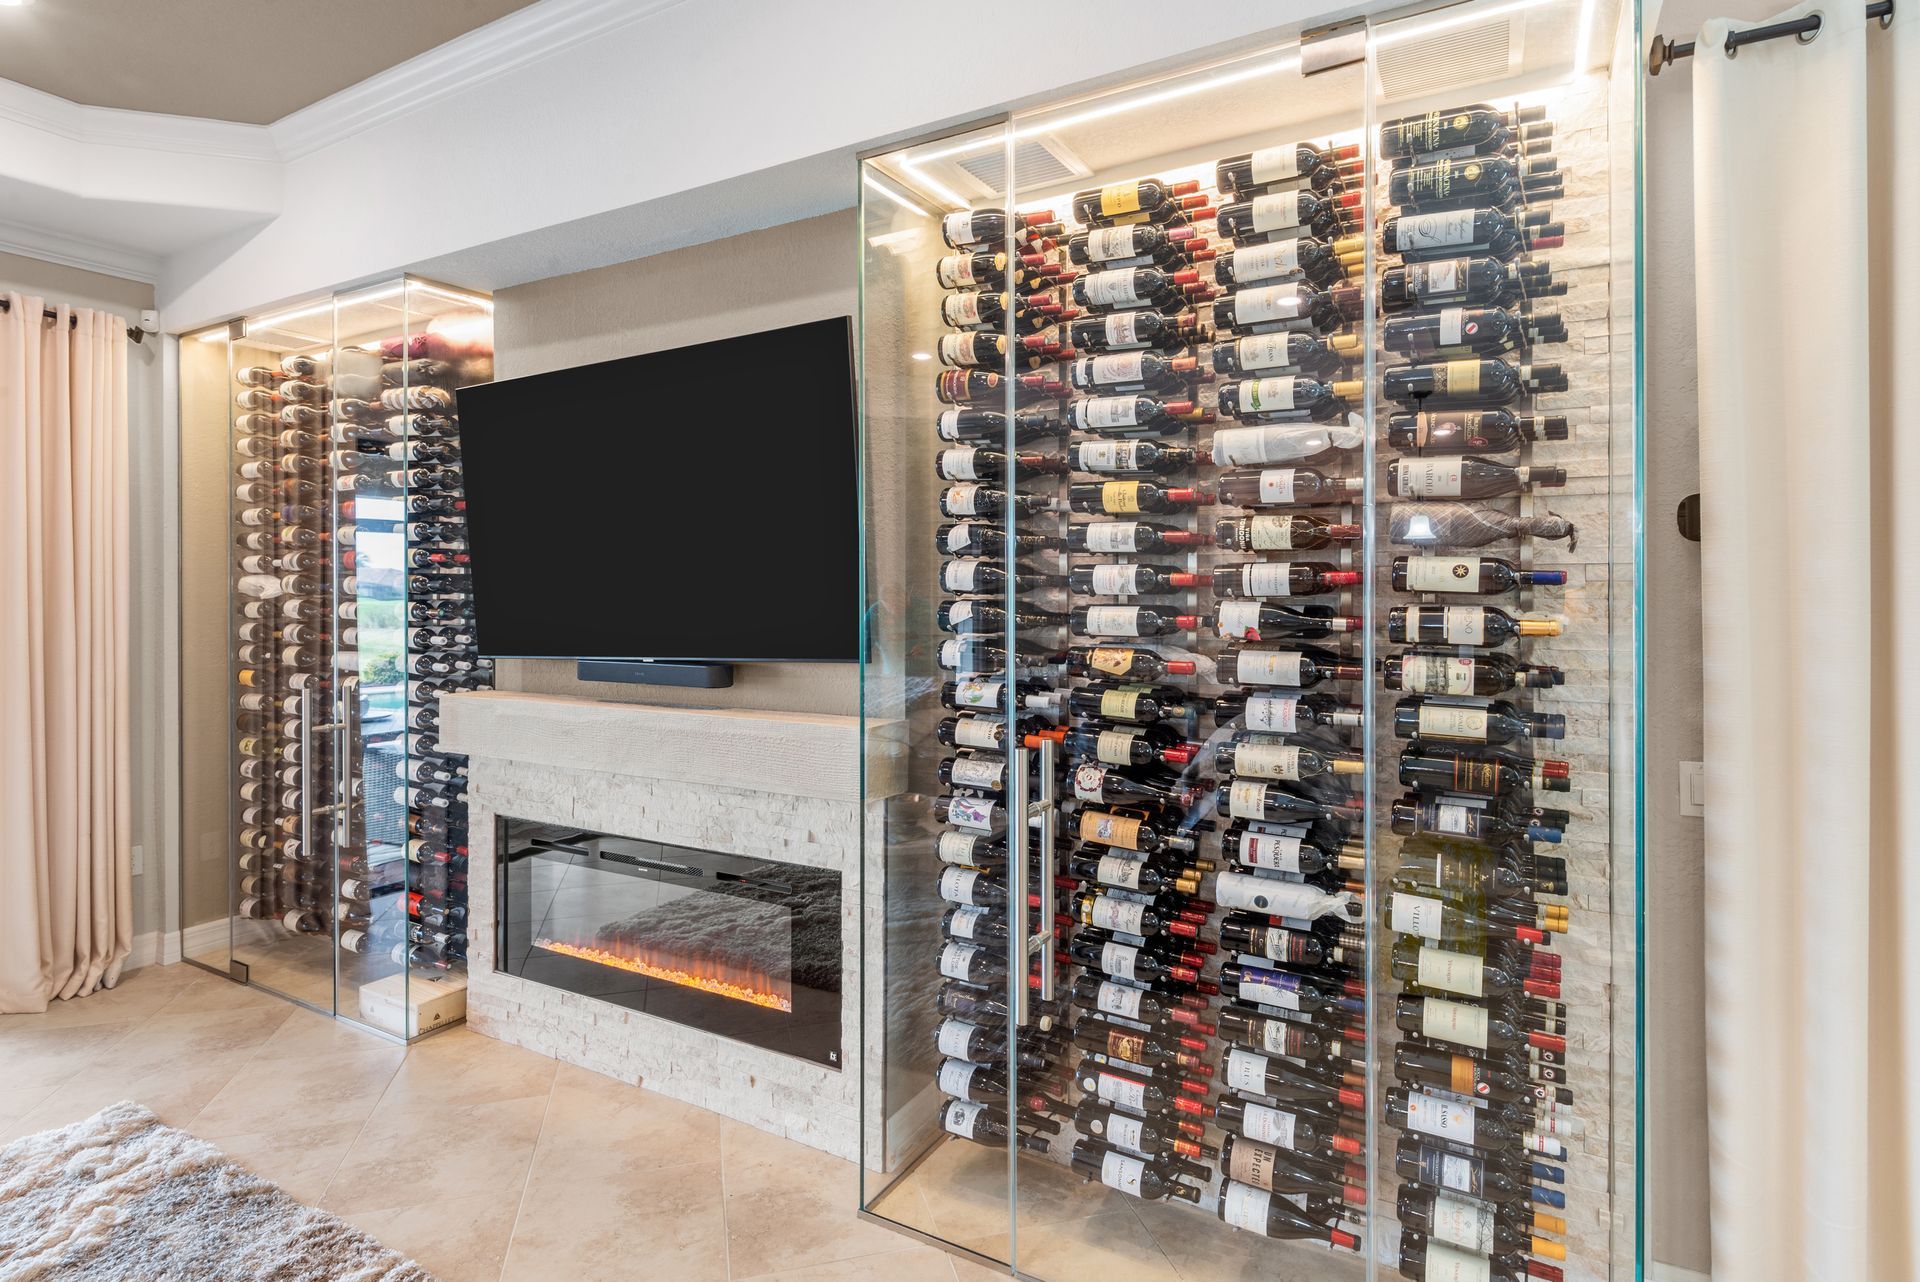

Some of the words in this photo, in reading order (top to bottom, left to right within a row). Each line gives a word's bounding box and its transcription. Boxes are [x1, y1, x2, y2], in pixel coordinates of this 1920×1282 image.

[1425, 463, 1434, 494] BAROLO
[1272, 839, 1281, 868] PESQUERA
[1263, 1151, 1274, 1162] UN
